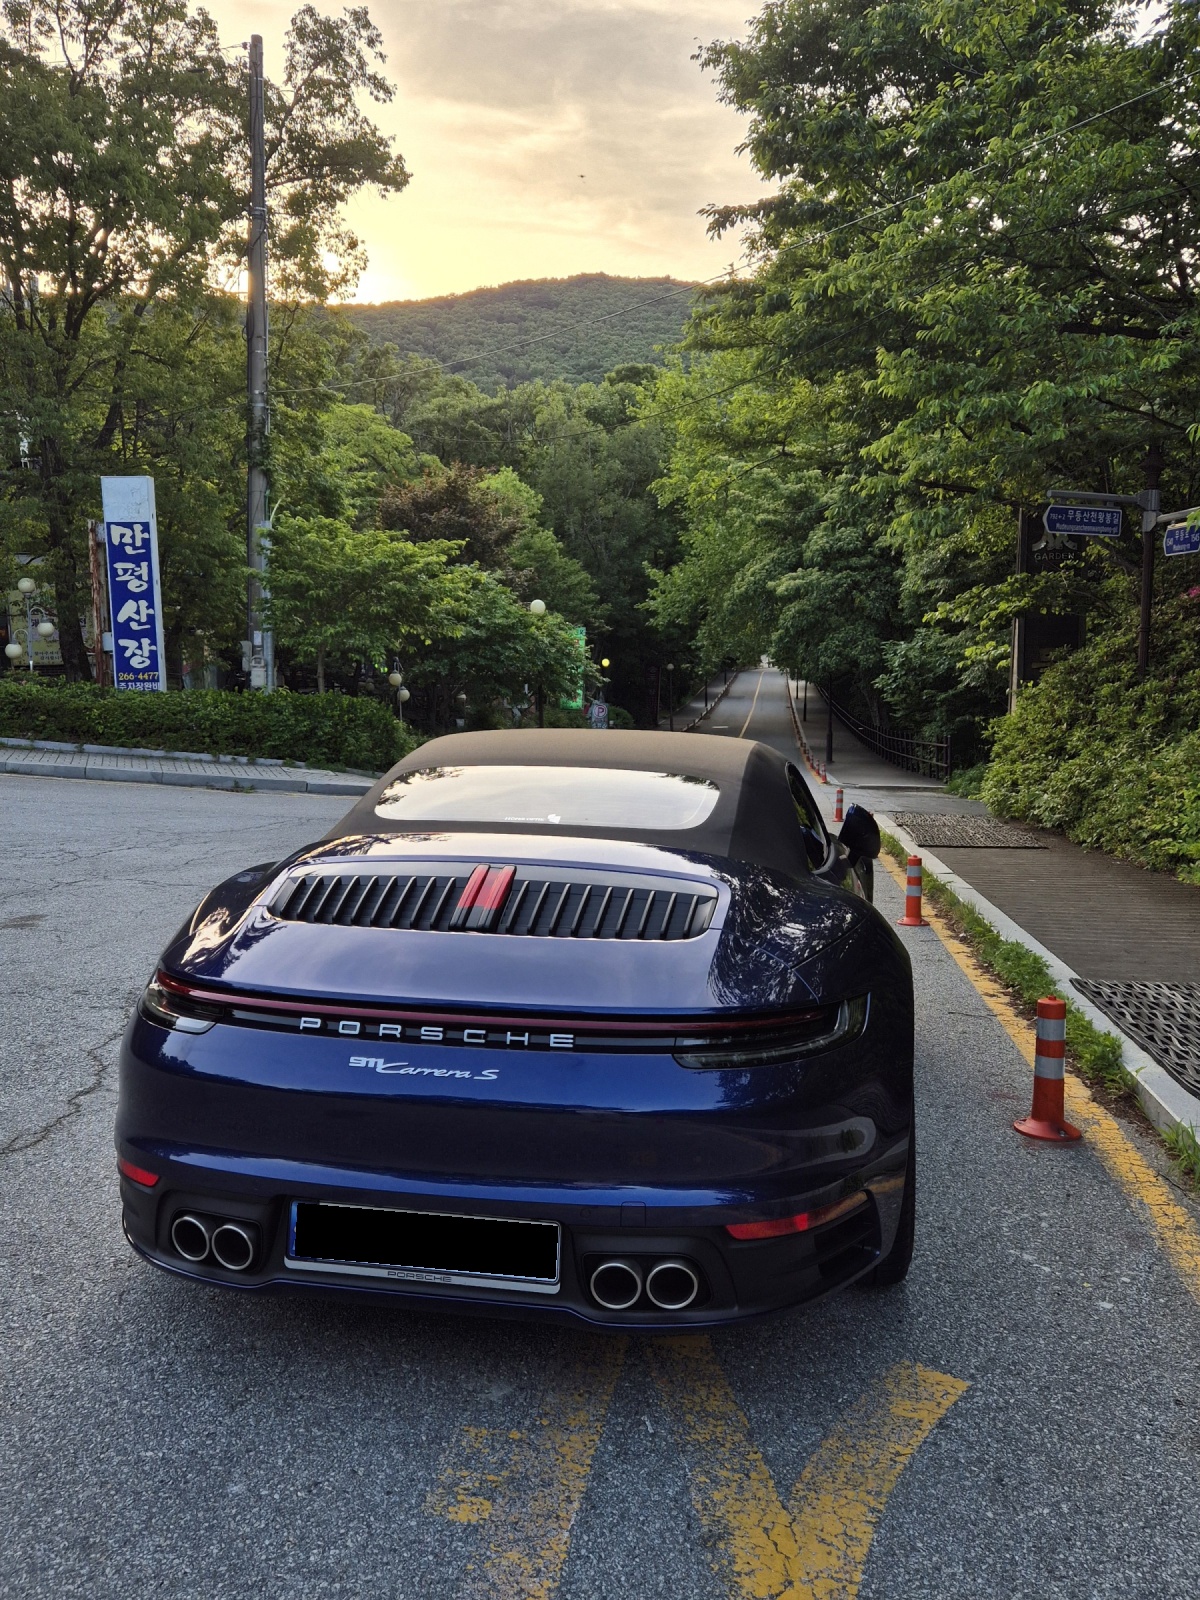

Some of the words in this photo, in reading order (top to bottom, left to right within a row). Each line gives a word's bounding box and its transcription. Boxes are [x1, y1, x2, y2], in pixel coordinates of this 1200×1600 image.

[1034, 552, 1075, 560] GARDEN
[110, 523, 157, 669] 만평산장
[118, 671, 159, 681] 266-4477
[299, 1016, 574, 1048] PORSCHE
[376, 1062, 472, 1079] Carrera
[473, 1069, 500, 1080] S
[387, 1270, 452, 1283] PORSCHE
